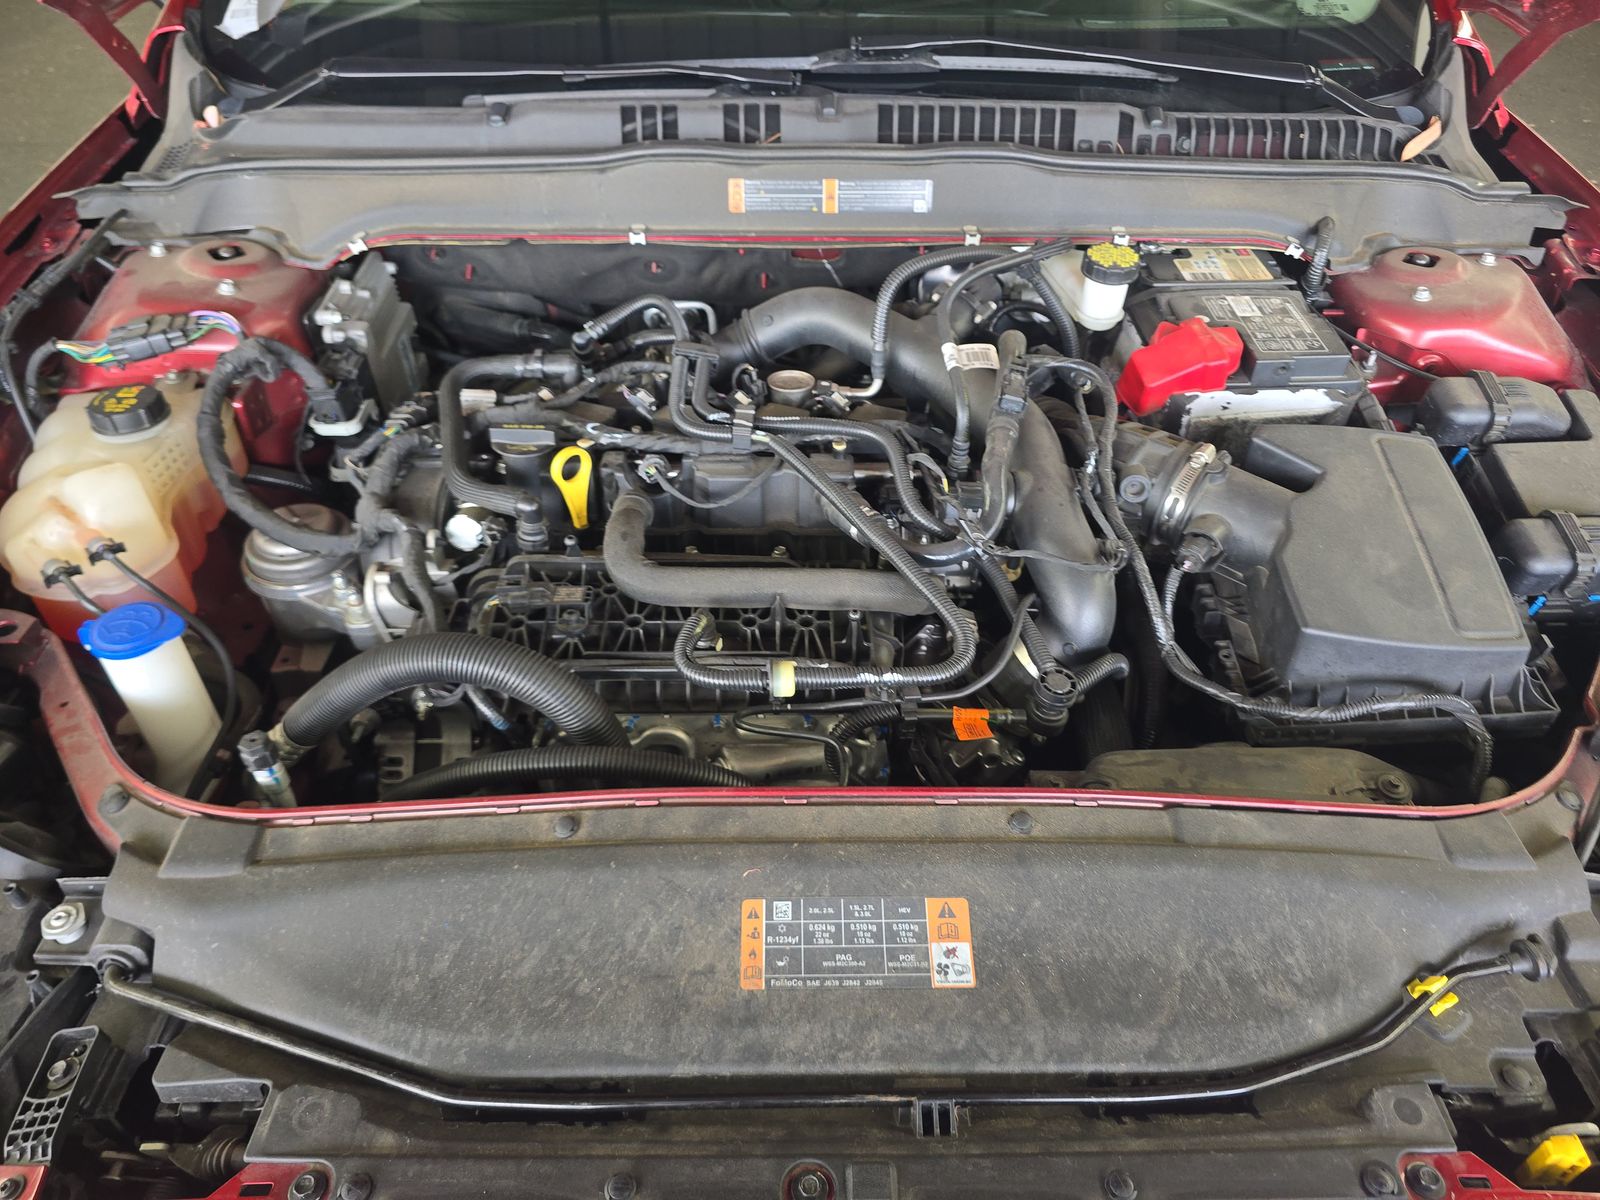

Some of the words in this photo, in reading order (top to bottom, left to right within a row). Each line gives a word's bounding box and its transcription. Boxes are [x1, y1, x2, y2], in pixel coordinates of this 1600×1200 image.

[808, 923, 826, 931] 0.624
[826, 923, 836, 933] kg
[868, 923, 877, 932] kg
[910, 923, 919, 932] kg
[767, 935, 799, 944] R-1234yf
